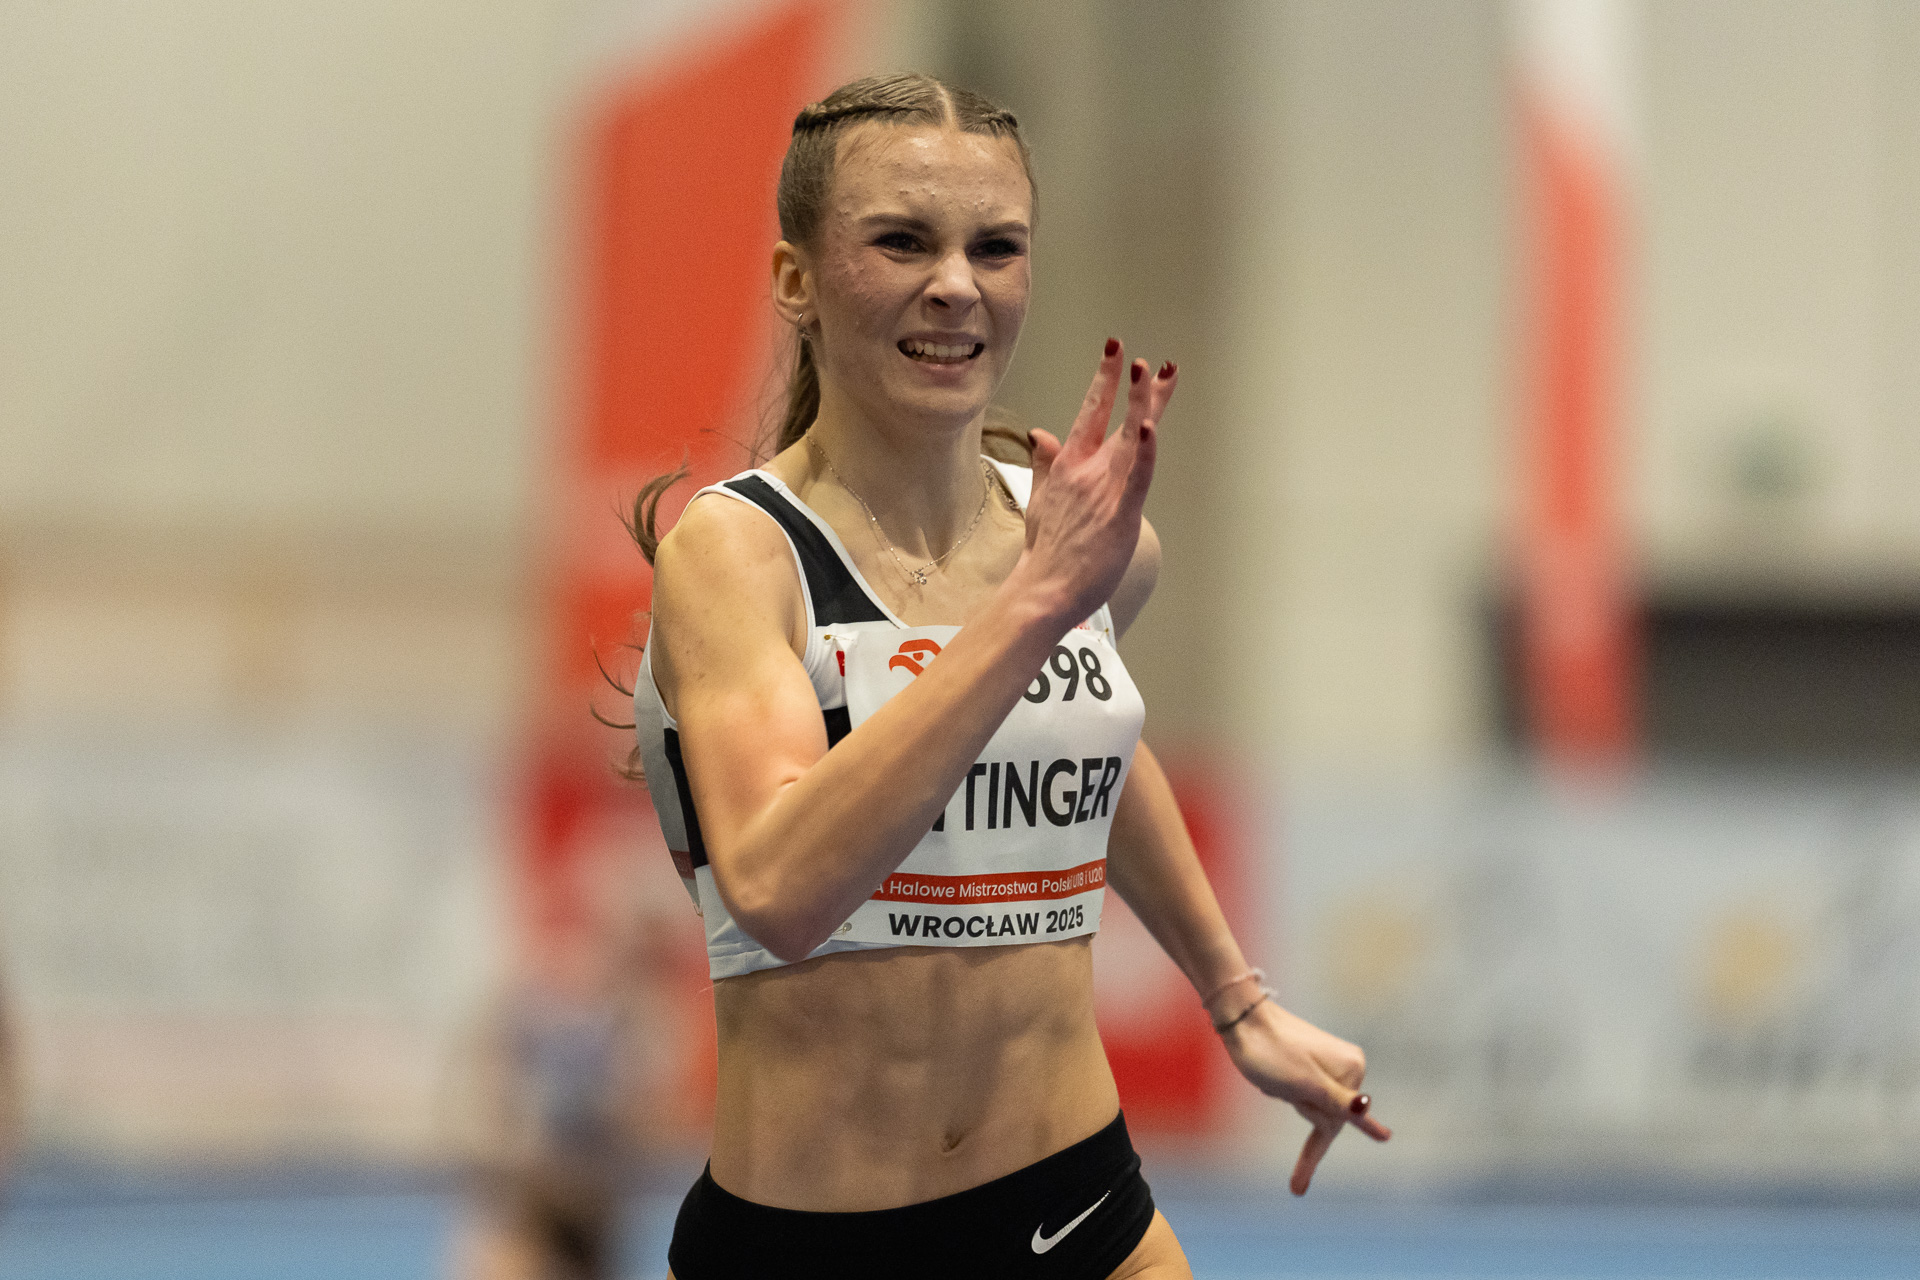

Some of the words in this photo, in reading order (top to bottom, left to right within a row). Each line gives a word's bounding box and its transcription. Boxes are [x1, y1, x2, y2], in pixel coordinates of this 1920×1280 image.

[932, 756, 1122, 832] TINGER
[889, 880, 956, 898] Halowe
[959, 881, 1038, 898] Mistrzostwa
[1041, 875, 1073, 893] Polski
[1089, 866, 1104, 884] U20
[888, 912, 1040, 938] WROCŁAW
[1046, 904, 1084, 934] 2025
